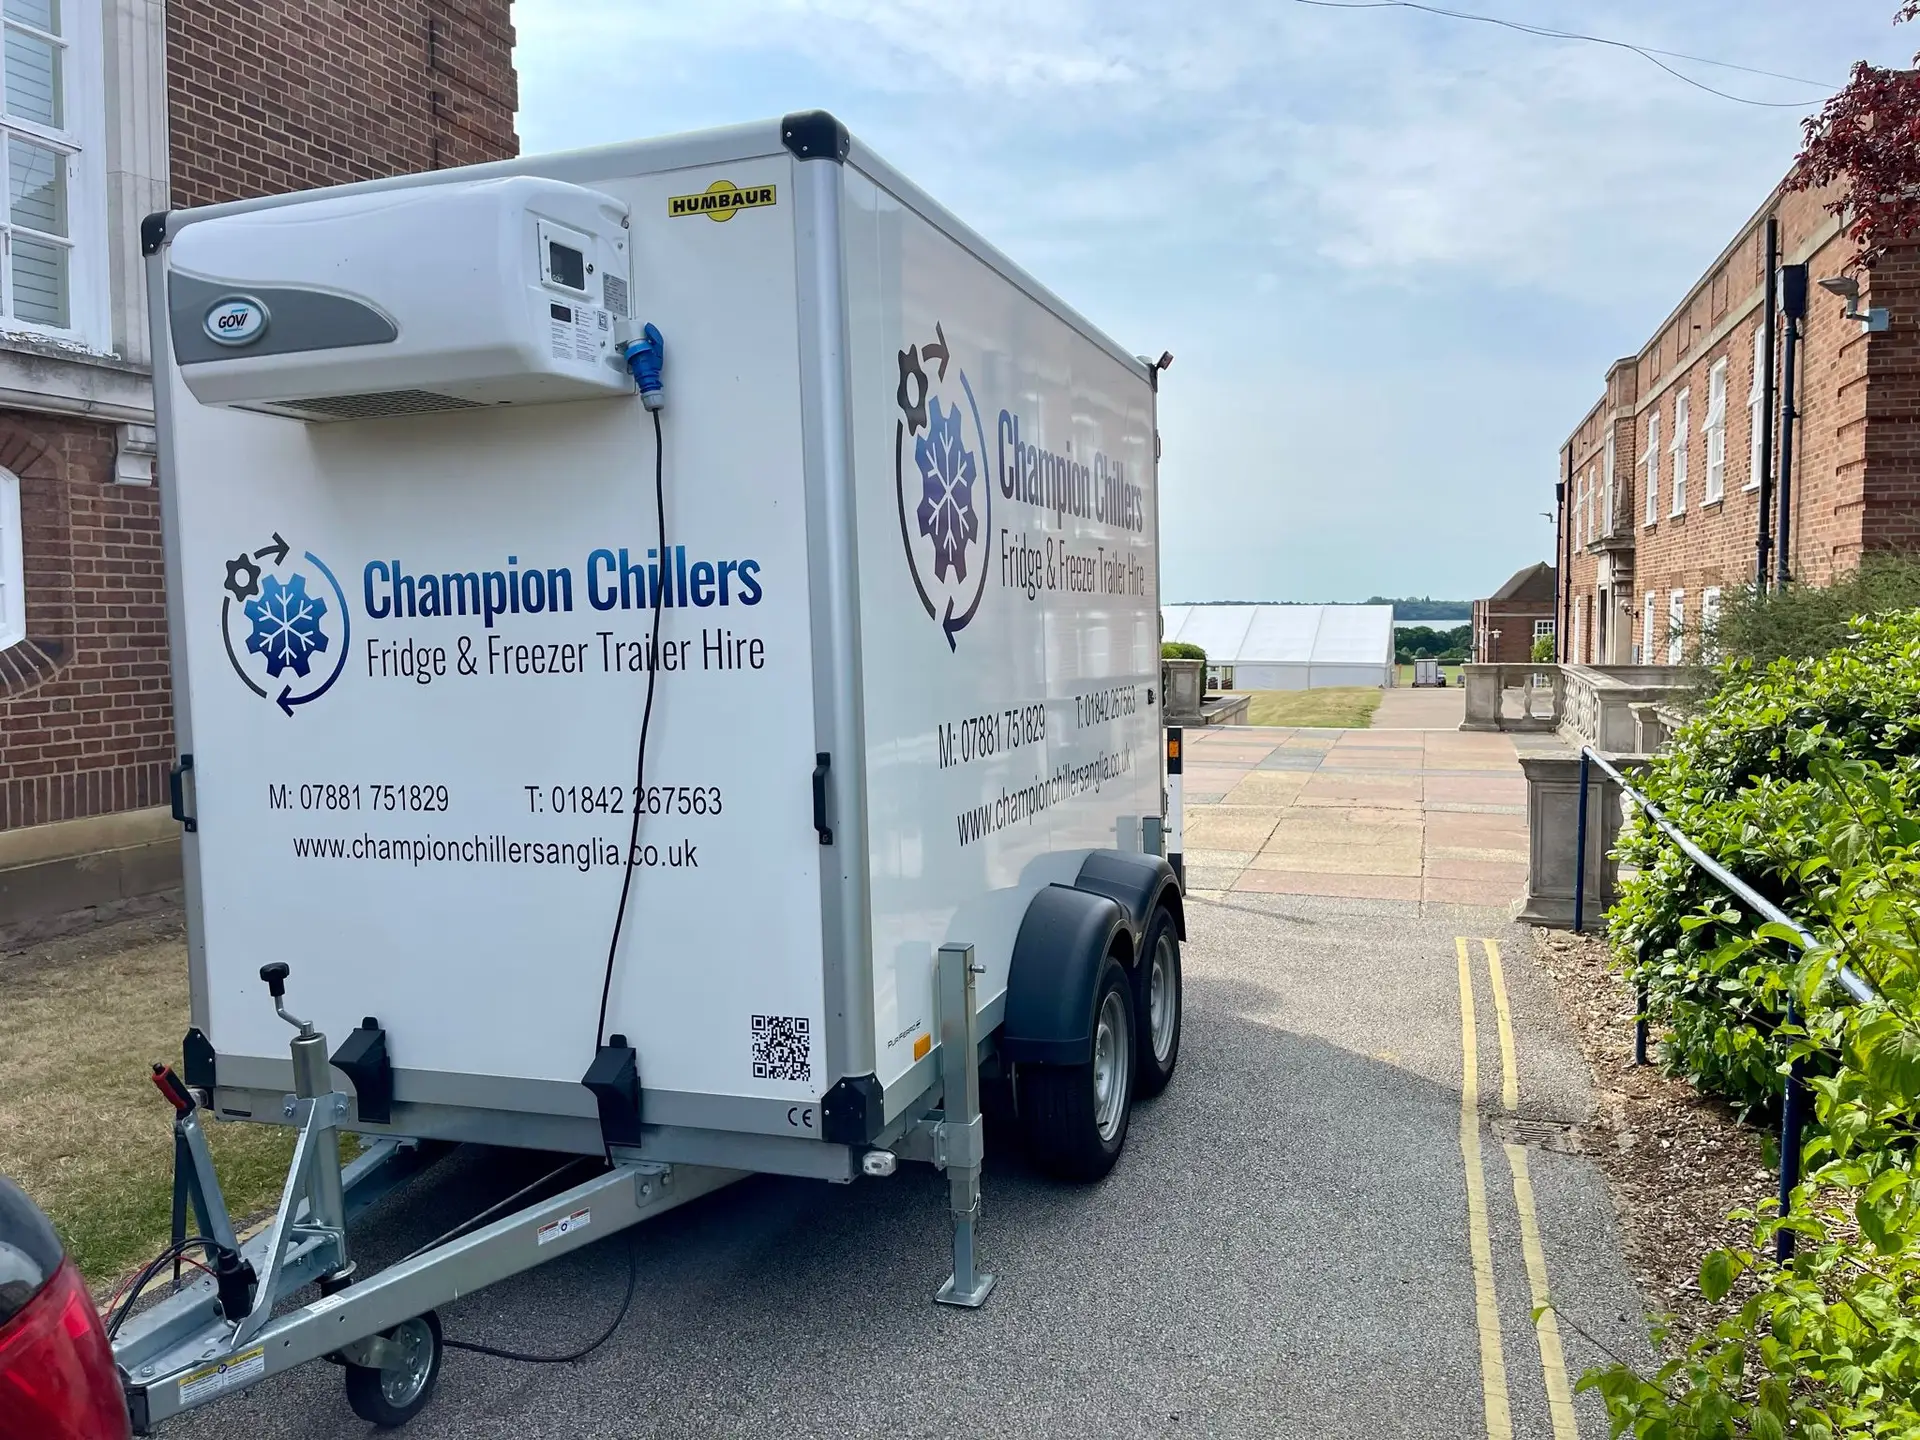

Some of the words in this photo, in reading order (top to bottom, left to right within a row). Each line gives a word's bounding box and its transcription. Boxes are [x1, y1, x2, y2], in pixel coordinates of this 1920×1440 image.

[673, 189, 772, 213] HUMBAUR
[218, 313, 248, 329] GOVI
[998, 409, 1091, 529] Champion
[1094, 451, 1143, 532] Chillers
[363, 556, 573, 628] Champion
[587, 545, 762, 611] Chillers
[1001, 529, 1042, 601] Fridge
[1046, 537, 1056, 590] &
[1059, 540, 1097, 593] Freezer
[1098, 547, 1126, 595] Trailer
[1129, 552, 1145, 596] Hire
[367, 638, 446, 684] Fridge
[457, 636, 478, 675] &
[488, 635, 588, 674] Freezer
[596, 631, 691, 672] Trailer
[703, 628, 765, 670] Hire
[1075, 695, 1083, 729] T:
[1085, 690, 1109, 727] 01842
[1110, 684, 1135, 719] 267563
[939, 722, 957, 769] M:
[961, 713, 1000, 762] 07881
[1005, 704, 1045, 749] 751829
[269, 784, 293, 809] M:
[300, 784, 361, 810] 07881
[370, 785, 449, 811] 751829
[525, 786, 543, 813] T:
[552, 786, 624, 814] 01842
[632, 786, 722, 815] 267563
[957, 742, 1132, 846] www.championchillersanglia.co.uk
[293, 832, 698, 872] www.championchillersanglia.co.uk
[787, 1107, 812, 1128] CE
